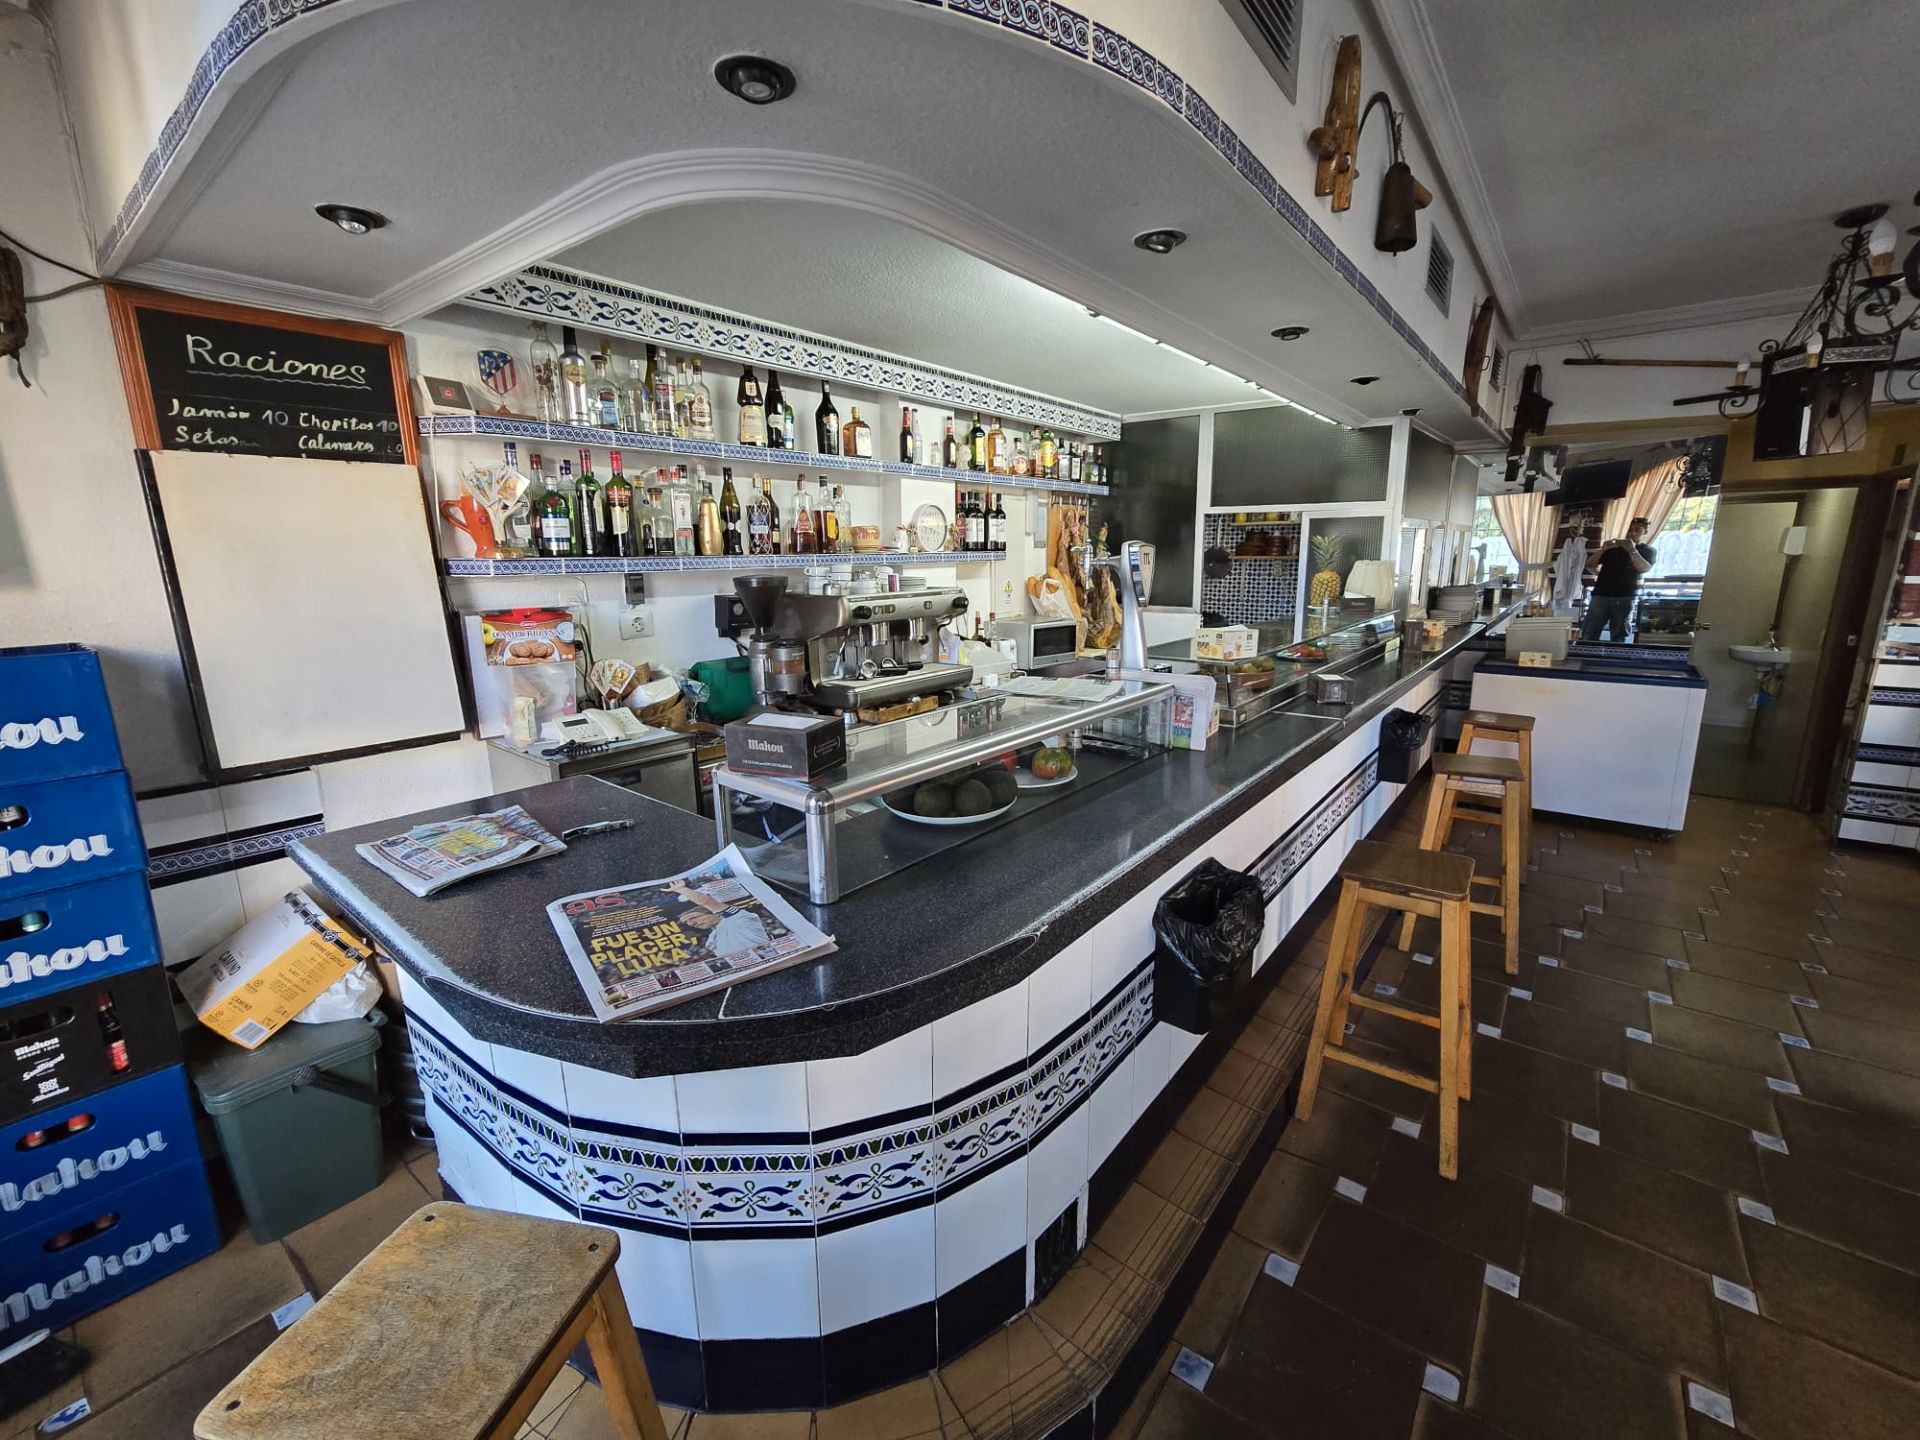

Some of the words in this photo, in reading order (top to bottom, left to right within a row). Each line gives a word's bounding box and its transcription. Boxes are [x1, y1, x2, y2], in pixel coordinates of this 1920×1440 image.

[185, 334, 367, 385] Raciones
[261, 410, 289, 426] 10
[299, 412, 374, 431] Chopitos
[376, 420, 399, 433] 10
[175, 425, 239, 446] Setas
[747, 738, 785, 754] Mahou
[590, 930, 642, 953] FUE
[642, 920, 682, 941] UN
[590, 933, 698, 967] PLACER,
[616, 947, 692, 977] LUKA
